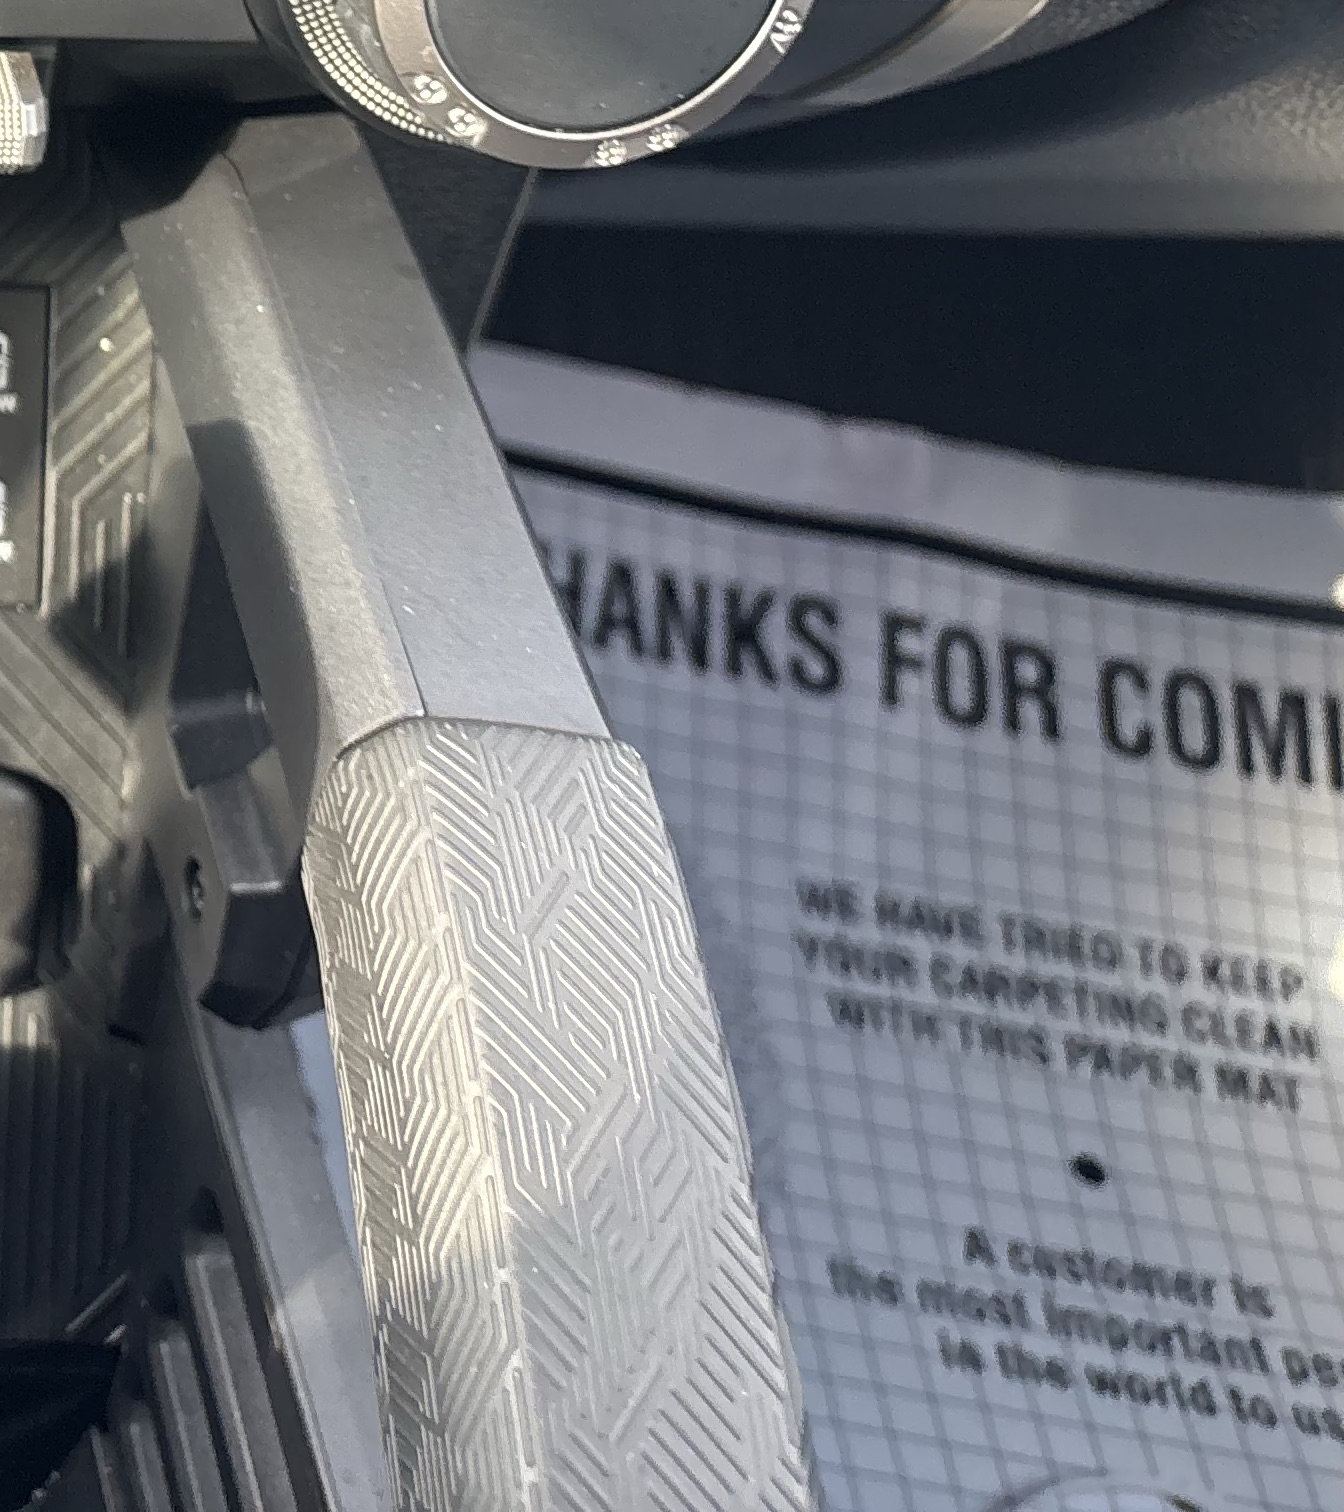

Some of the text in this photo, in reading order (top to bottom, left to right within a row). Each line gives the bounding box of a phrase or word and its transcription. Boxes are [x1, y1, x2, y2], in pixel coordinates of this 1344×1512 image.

[874, 607, 1062, 744] FOR
[1098, 652, 1344, 793] COMI
[789, 928, 1320, 1065] YOUR CARPETING CLEAN
[795, 876, 1306, 1004] WE HAVE TRIED TO KEEP
[824, 989, 1302, 1115] WITH THIS PAPER MAT
[825, 1255, 904, 1307] the
[915, 1276, 1032, 1331] most
[1041, 1291, 1272, 1377] important
[963, 1224, 1277, 1320] A customer is
[994, 1340, 1070, 1390] the
[1083, 1361, 1219, 1418] world
[1227, 1384, 1278, 1432] to
